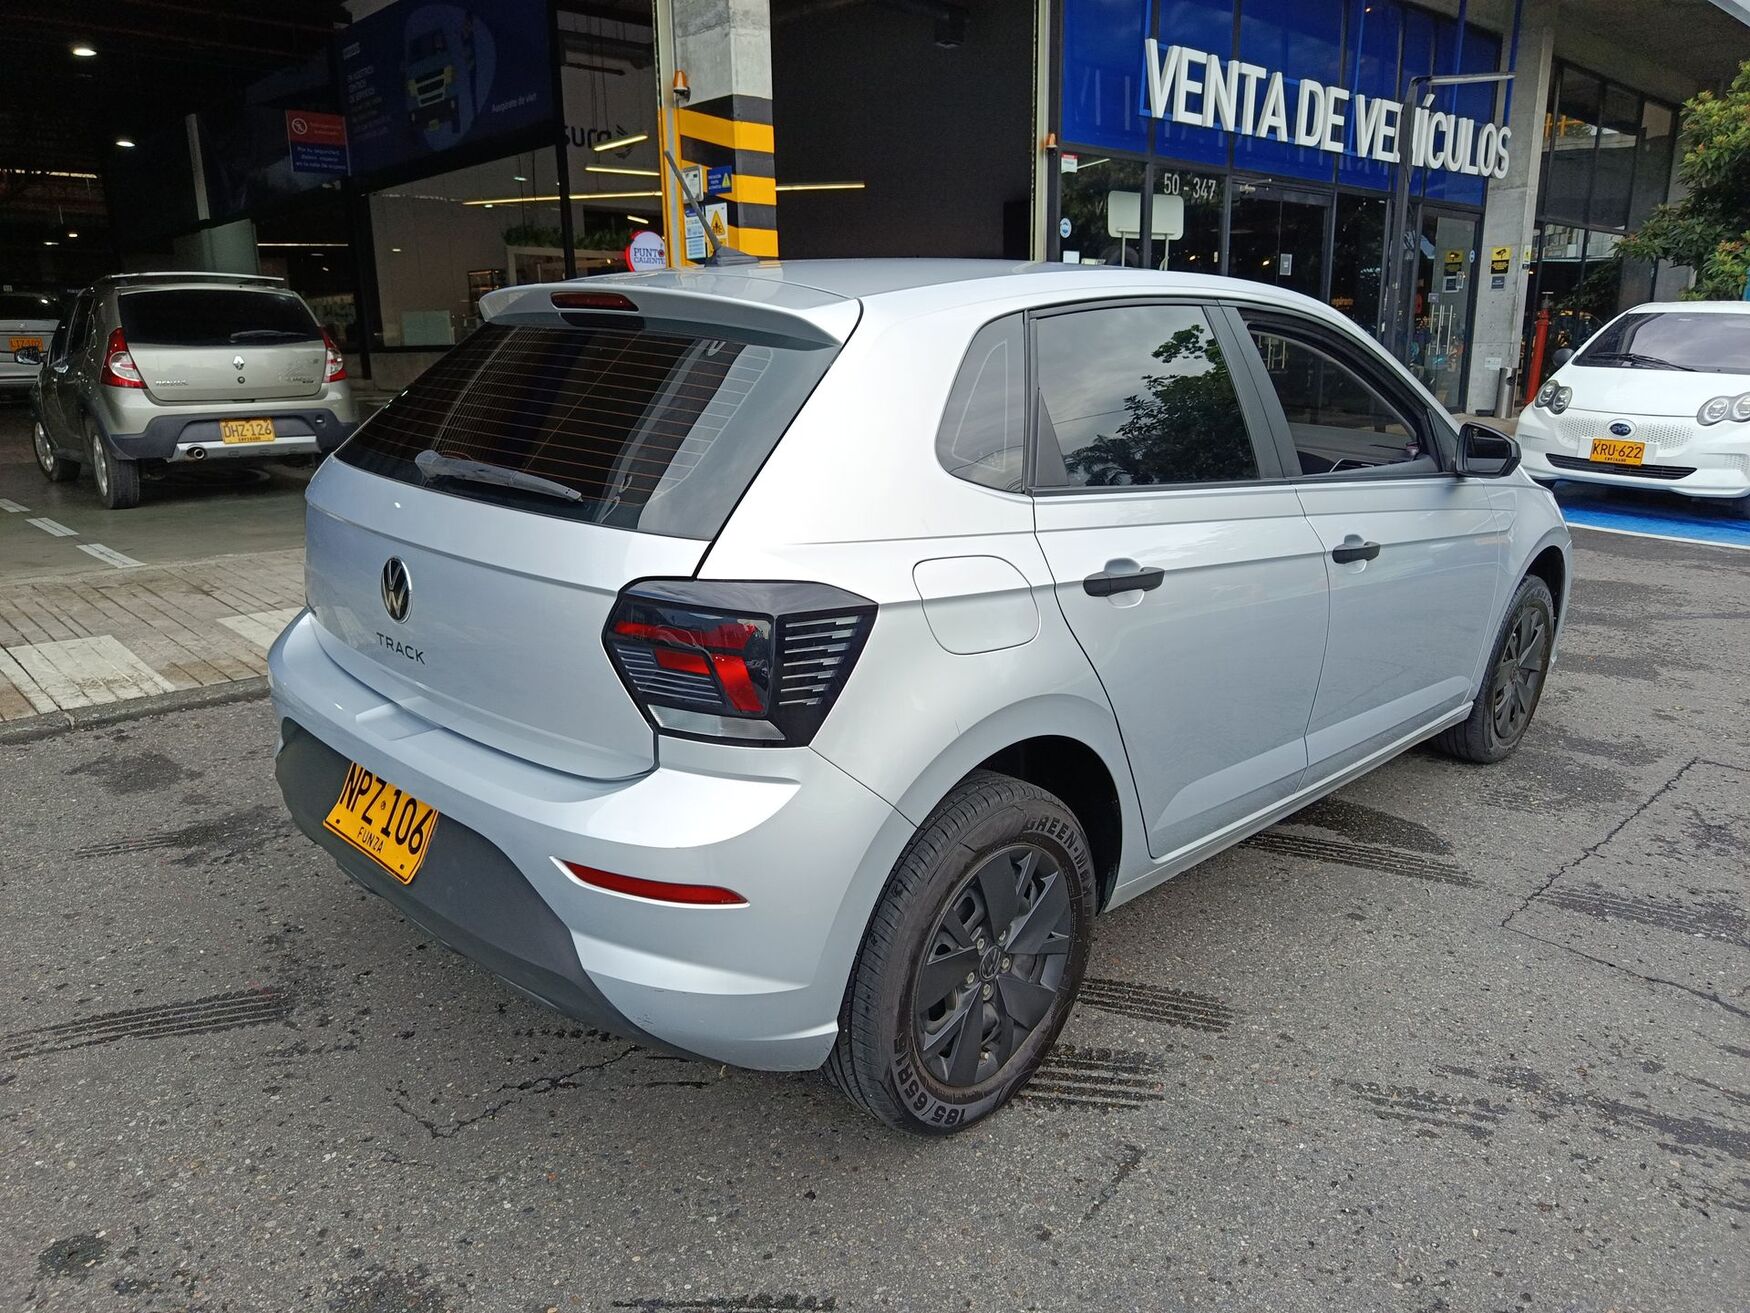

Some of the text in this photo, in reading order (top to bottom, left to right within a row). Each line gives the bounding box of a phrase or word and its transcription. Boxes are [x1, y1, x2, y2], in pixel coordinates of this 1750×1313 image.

[1145, 38, 1512, 179] VENTA DE VEHÍCULOS
[1164, 173, 1180, 196] 50
[1192, 177, 1217, 201] 347
[633, 247, 665, 258] PUNTO
[376, 631, 425, 665] TRACK
[356, 826, 384, 855] FUNZA
